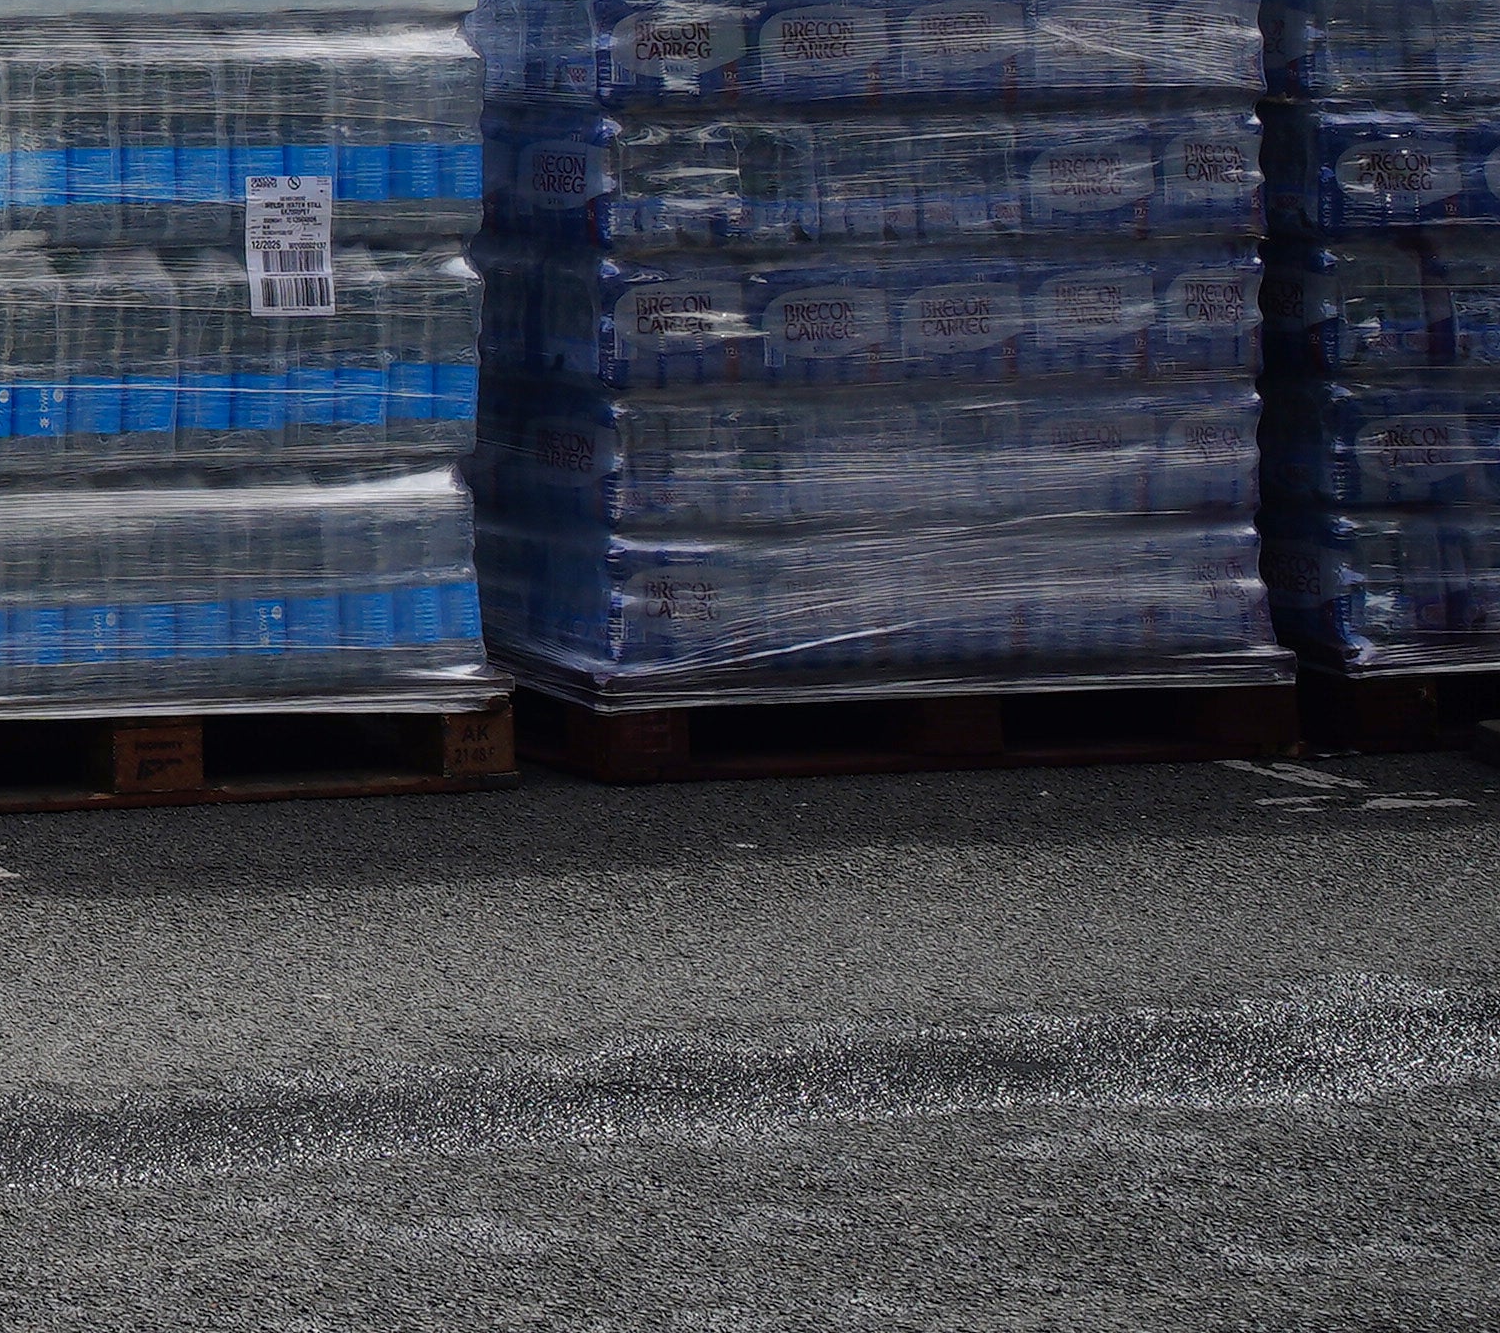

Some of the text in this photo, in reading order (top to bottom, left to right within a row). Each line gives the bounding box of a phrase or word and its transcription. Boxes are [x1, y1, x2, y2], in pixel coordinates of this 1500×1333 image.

[634, 22, 710, 41] BRECON
[782, 21, 854, 40] BRECON
[635, 42, 711, 60] CARREG
[782, 42, 855, 59] CARREG
[1185, 144, 1245, 163] BRECON
[1185, 284, 1244, 303] BRECON
[784, 301, 855, 322] BRECON
[921, 298, 990, 316] BRECON
[785, 323, 855, 341] CARREG
[922, 317, 990, 335] CARREG
